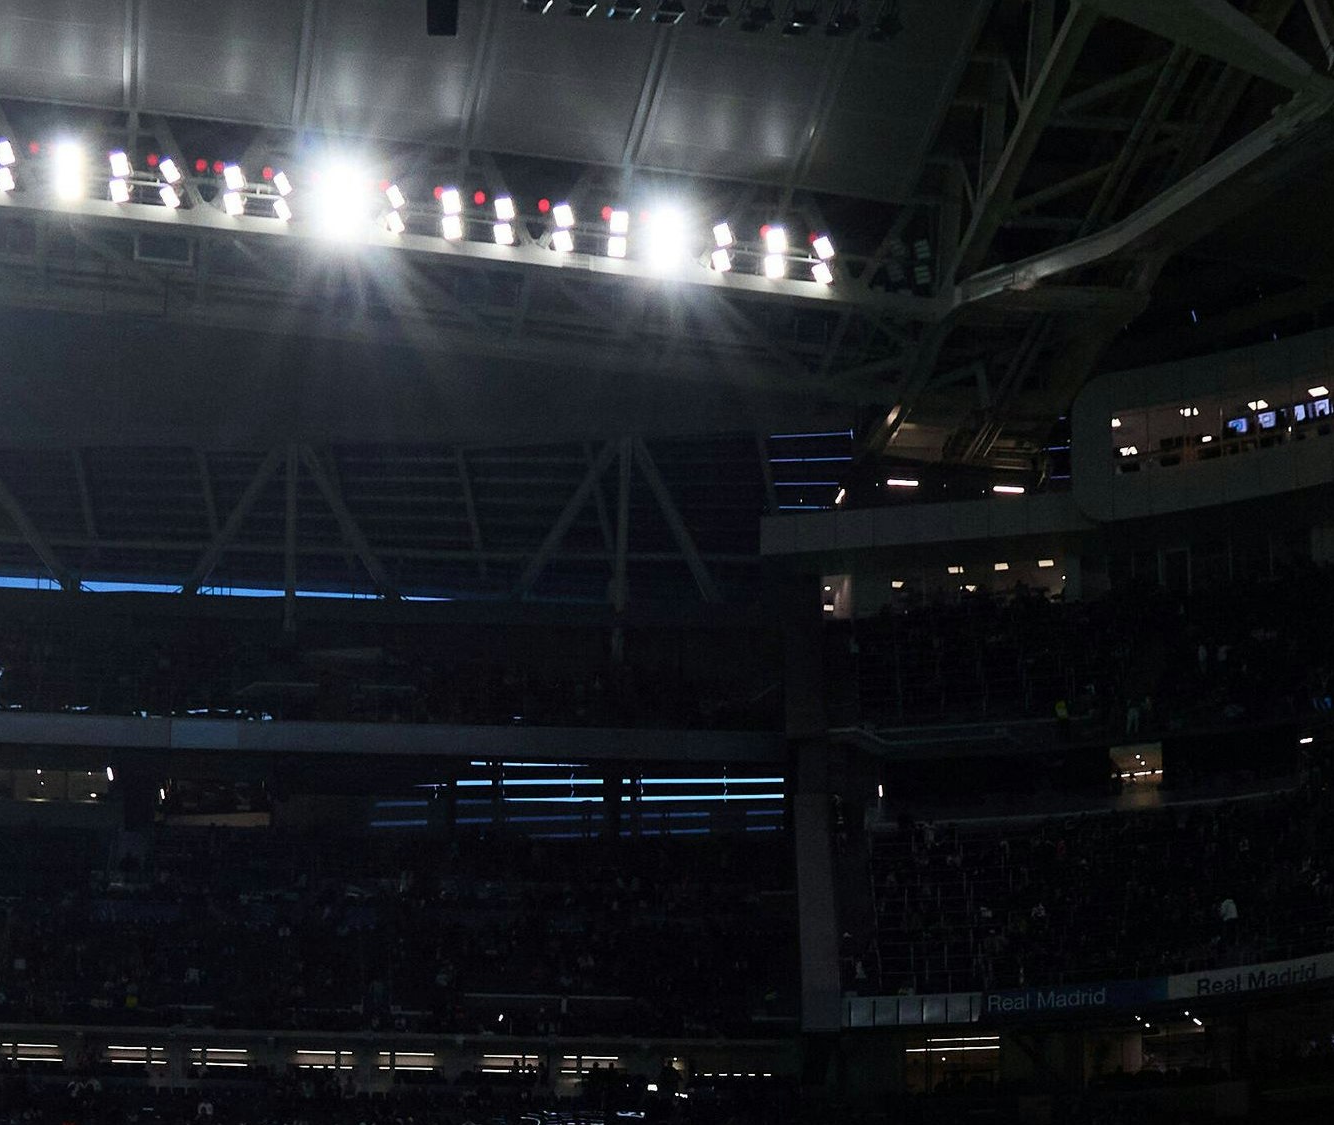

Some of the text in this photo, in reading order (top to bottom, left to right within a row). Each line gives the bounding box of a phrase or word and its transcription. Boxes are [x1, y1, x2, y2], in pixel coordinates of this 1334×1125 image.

[1197, 962, 1317, 995] Real Madrid
[987, 987, 1107, 1013] Real Madrid
